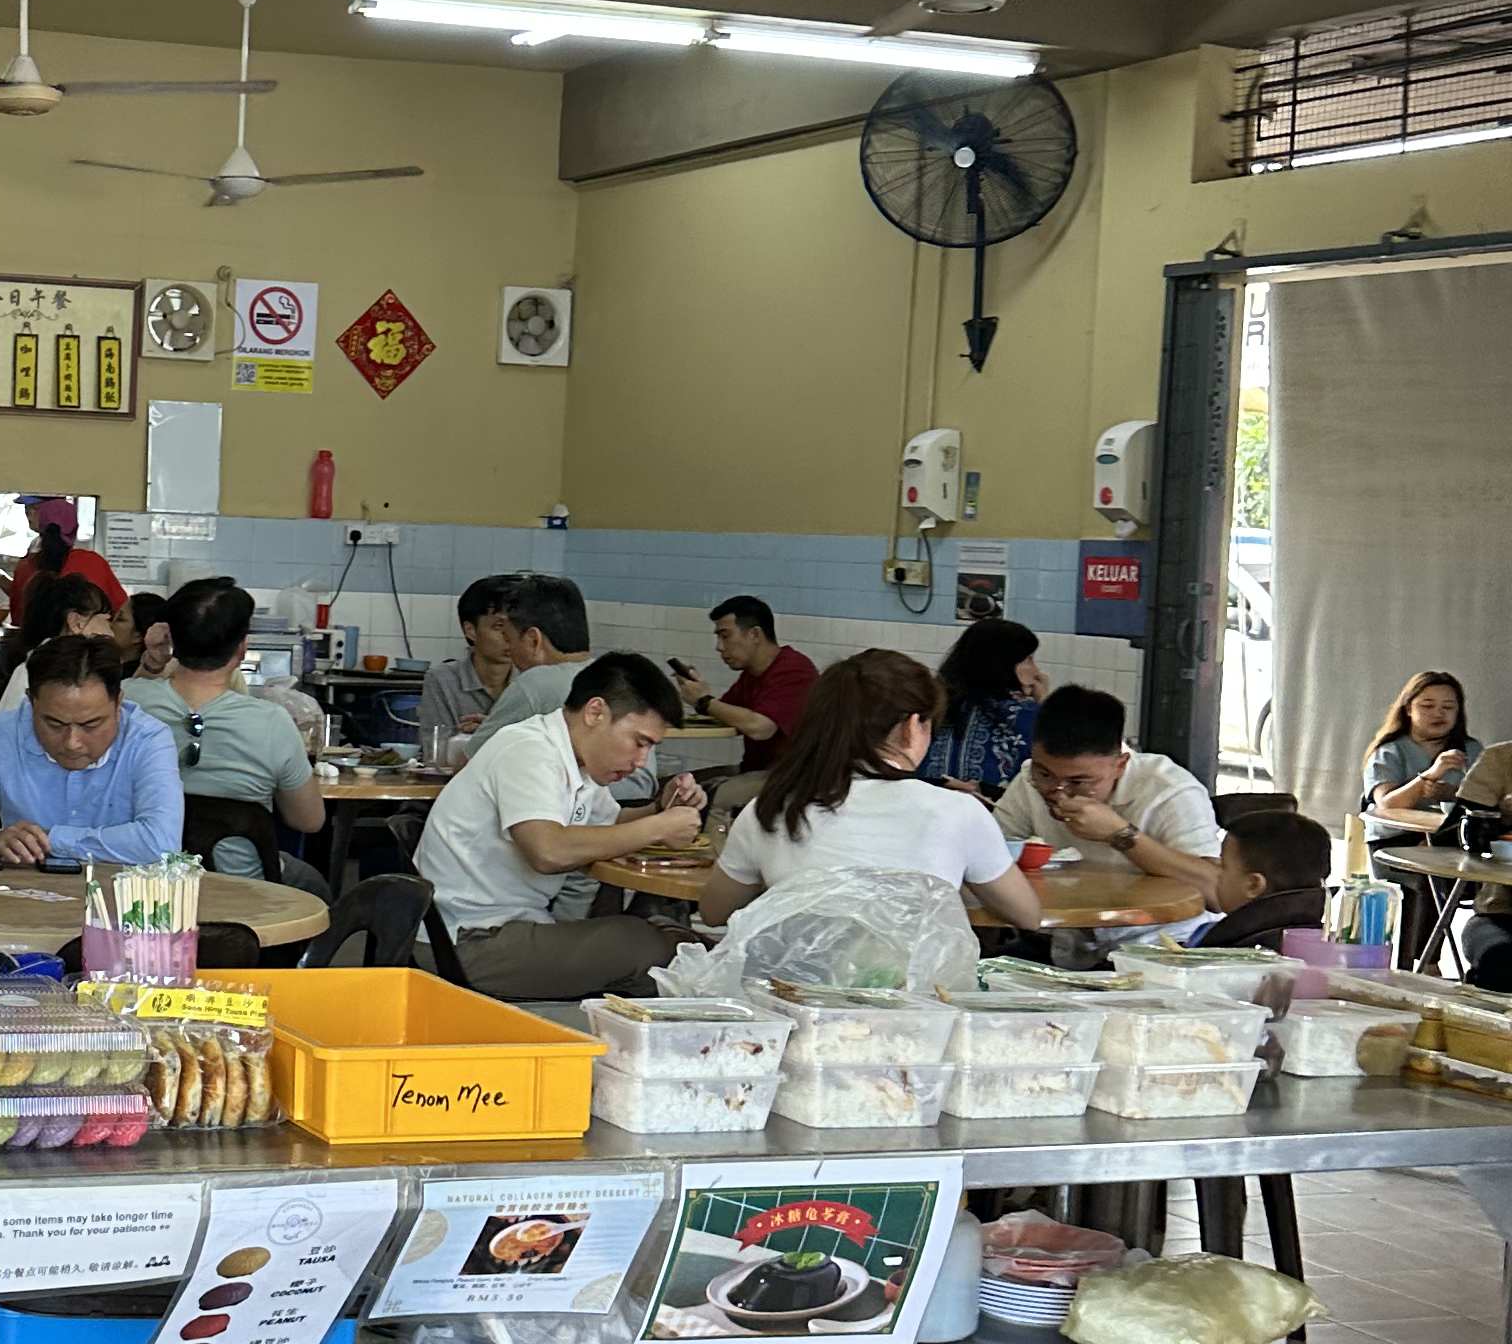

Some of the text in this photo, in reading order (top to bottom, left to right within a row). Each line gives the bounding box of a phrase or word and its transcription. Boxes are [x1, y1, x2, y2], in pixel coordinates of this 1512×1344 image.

[367, 320, 408, 365] 福
[1088, 564, 1138, 583] KELUAR
[392, 1073, 510, 1113] Tenom Mee
[447, 1188, 640, 1203] NATURAL COLLAGEN SWEET DESSERT
[2, 1217, 32, 1226] some
[34, 1215, 64, 1226] items
[66, 1214, 88, 1225] may
[91, 1213, 113, 1223] take
[115, 1211, 149, 1223] longer
[151, 1209, 173, 1220] time
[12, 1228, 45, 1239] Thank
[47, 1227, 67, 1238] you
[69, 1225, 84, 1236] for
[87, 1225, 111, 1236] your
[113, 1223, 156, 1235] patience
[298, 1254, 336, 1266] TAUSA
[269, 1285, 327, 1299] COCONUT
[257, 1314, 308, 1327] PEANUT
